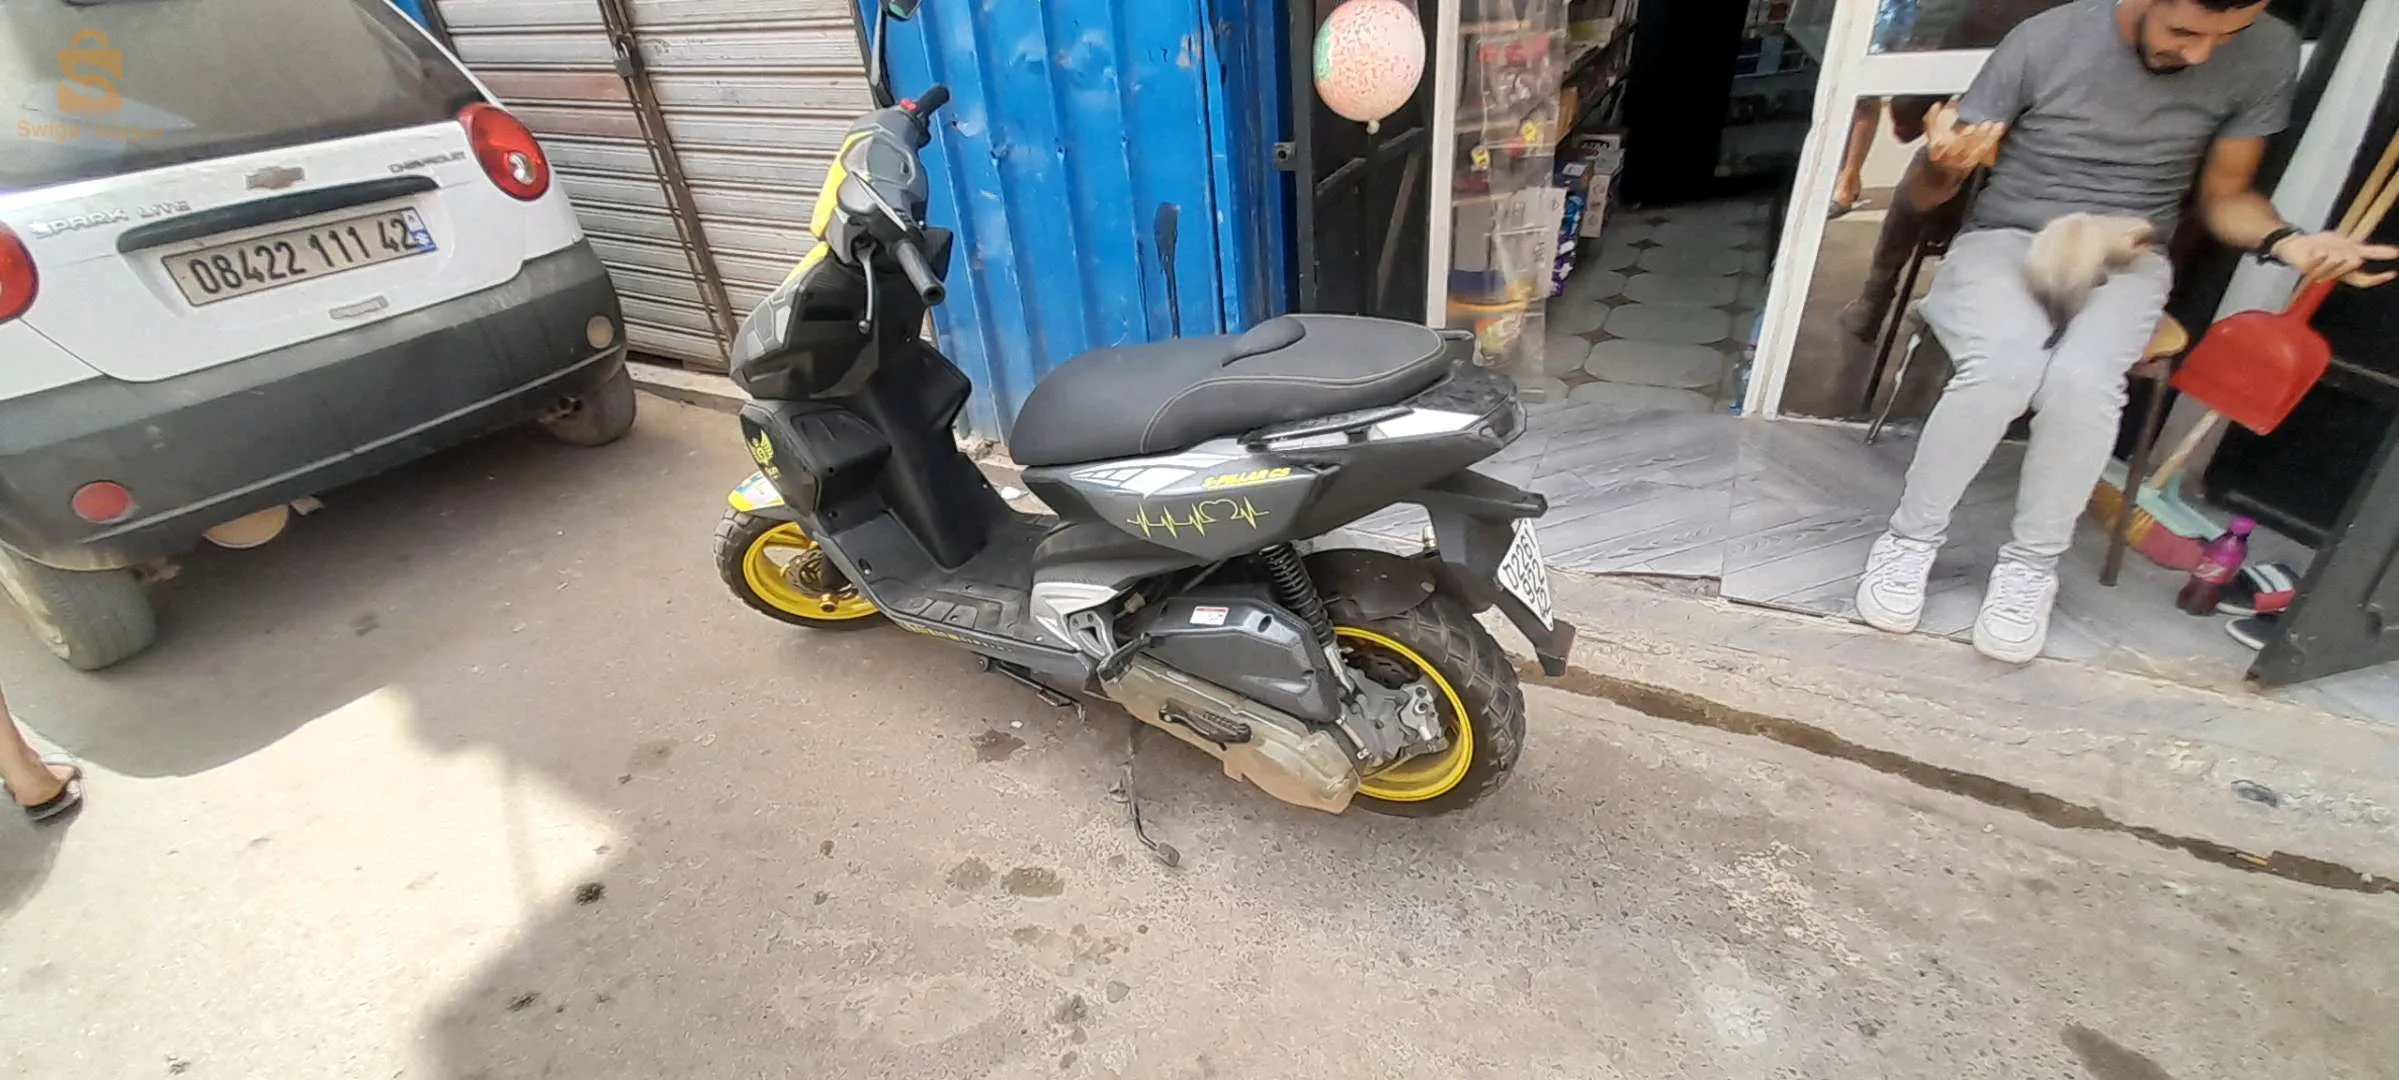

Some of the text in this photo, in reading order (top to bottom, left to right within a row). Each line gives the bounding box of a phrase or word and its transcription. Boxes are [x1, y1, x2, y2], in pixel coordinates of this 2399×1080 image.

[28, 206, 129, 240] SPARK
[188, 217, 418, 294] 08422 111 42
